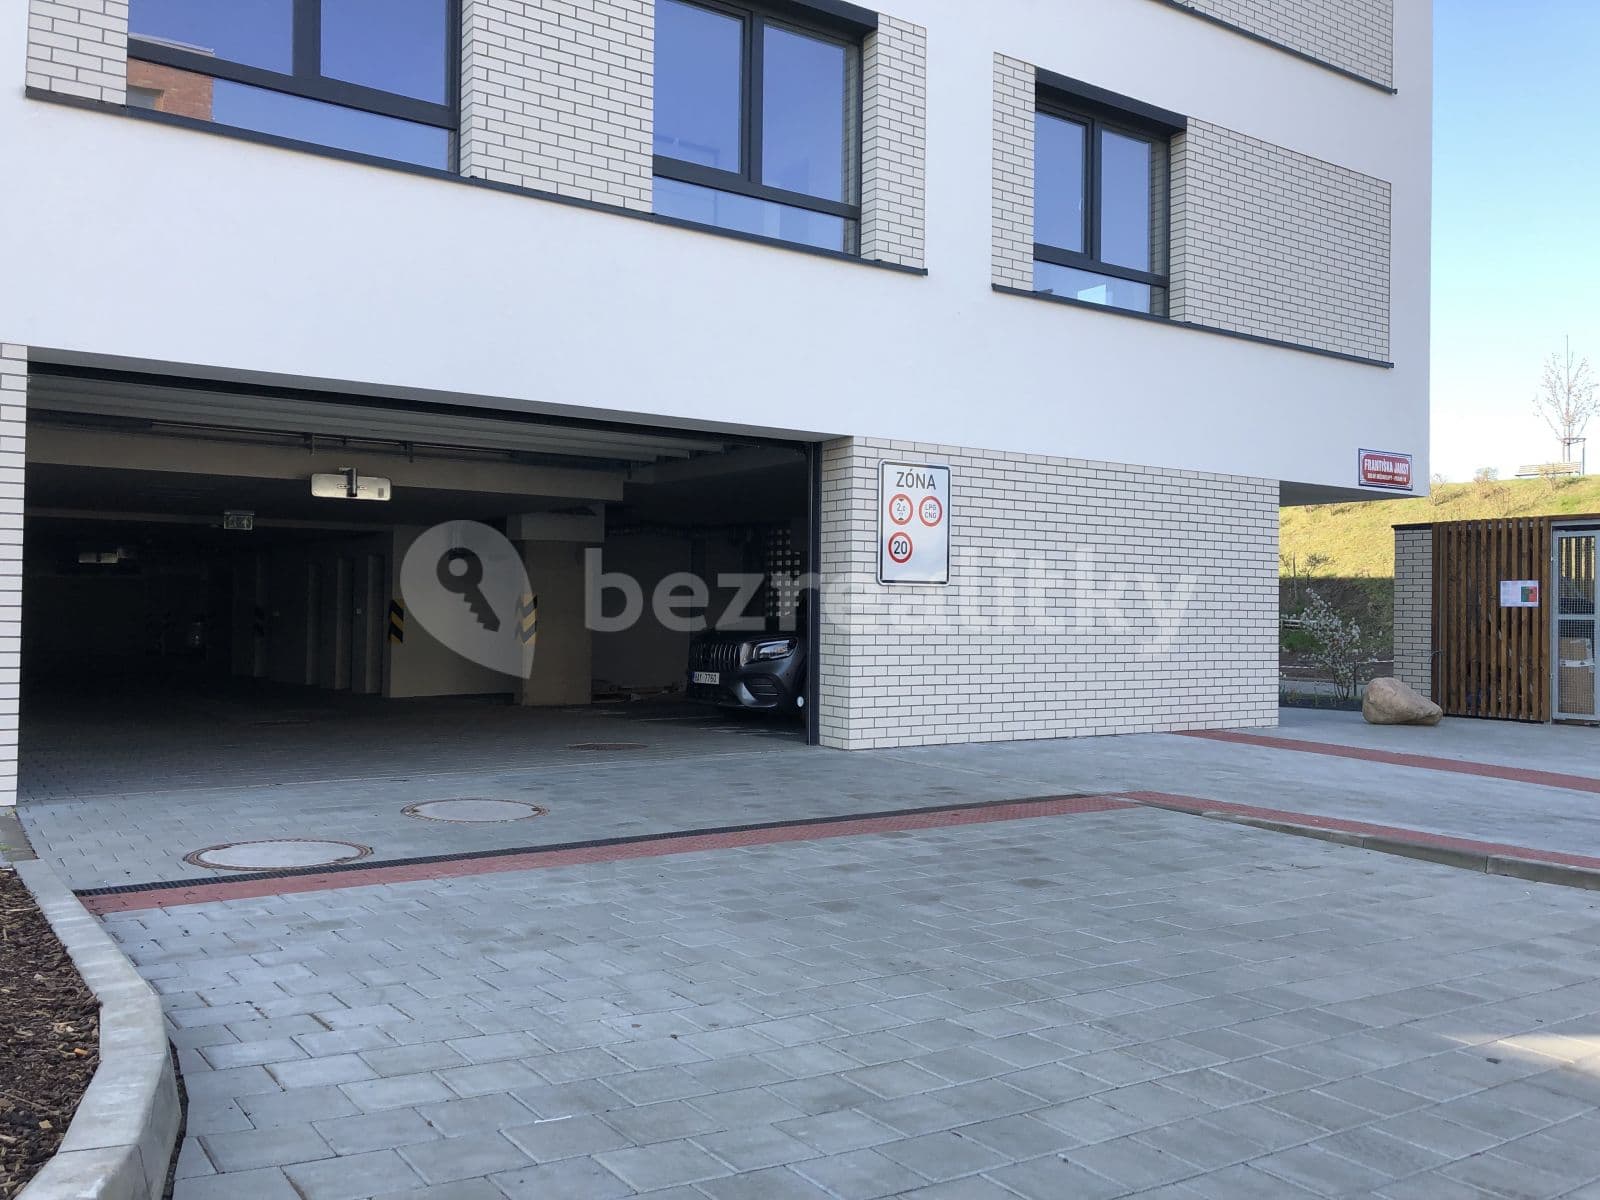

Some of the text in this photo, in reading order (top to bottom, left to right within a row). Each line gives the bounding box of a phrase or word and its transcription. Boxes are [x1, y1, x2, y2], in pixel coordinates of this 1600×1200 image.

[896, 469, 936, 490] ZÓNA
[925, 503, 937, 511] LPG
[924, 511, 937, 519] CNG
[893, 540, 908, 555] 20
